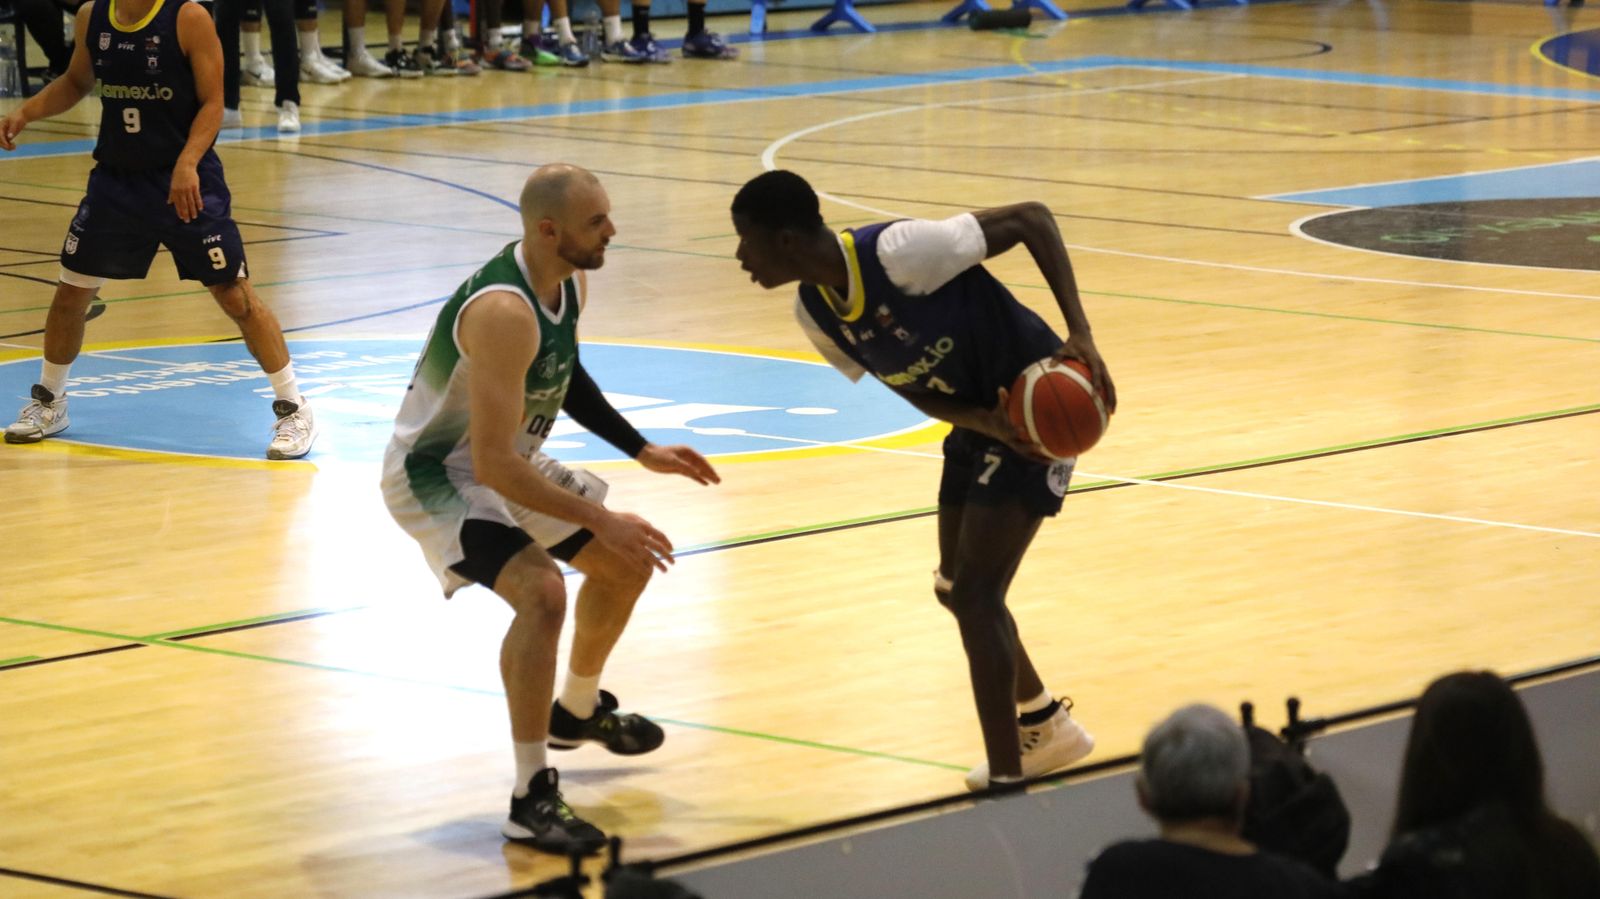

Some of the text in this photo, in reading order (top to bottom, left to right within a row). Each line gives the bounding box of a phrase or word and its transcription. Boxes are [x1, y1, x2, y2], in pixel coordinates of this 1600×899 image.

[122, 107, 142, 134] 9
[207, 246, 228, 271] 9
[977, 453, 1002, 486] 7
